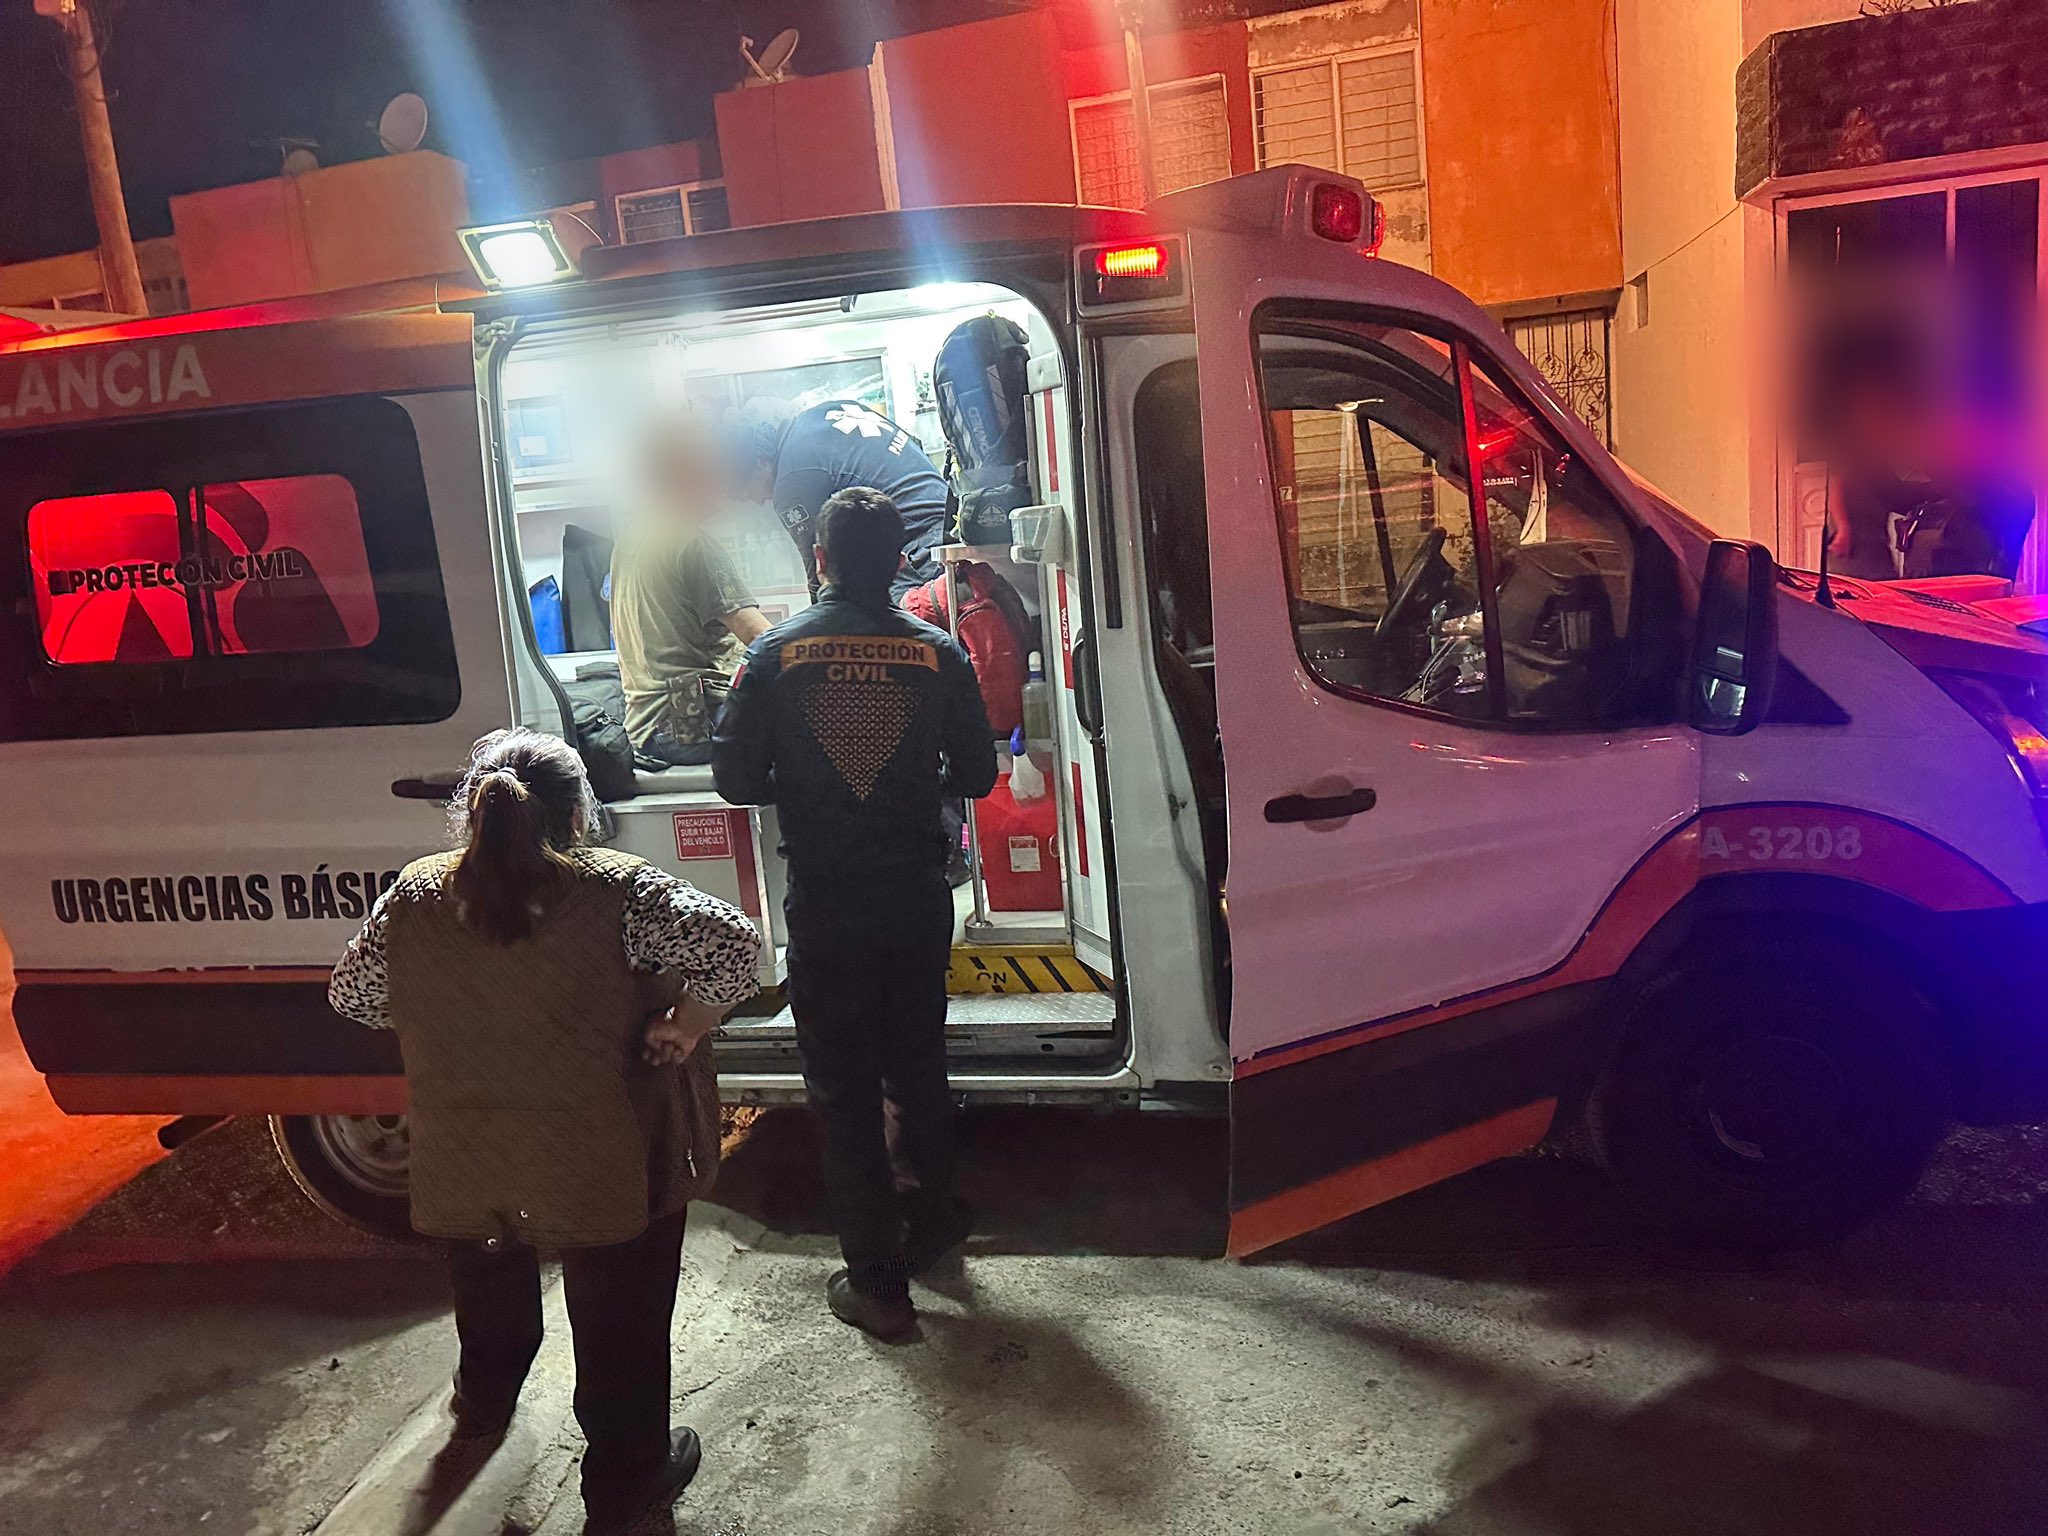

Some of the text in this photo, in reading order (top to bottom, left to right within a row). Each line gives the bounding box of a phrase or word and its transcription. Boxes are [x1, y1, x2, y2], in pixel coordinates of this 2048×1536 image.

[0, 344, 212, 417] ANCIA
[227, 550, 303, 581] CIVIL
[795, 641, 926, 662] PROTECCIÓN
[827, 664, 894, 682] CIVIL
[680, 828, 699, 838] SUBIR
[704, 826, 724, 836] BAJAR
[717, 817, 724, 826] AL
[682, 837, 695, 846] DEL
[1700, 825, 1862, 860] A-3208
[51, 873, 274, 923] URGENCIAS
